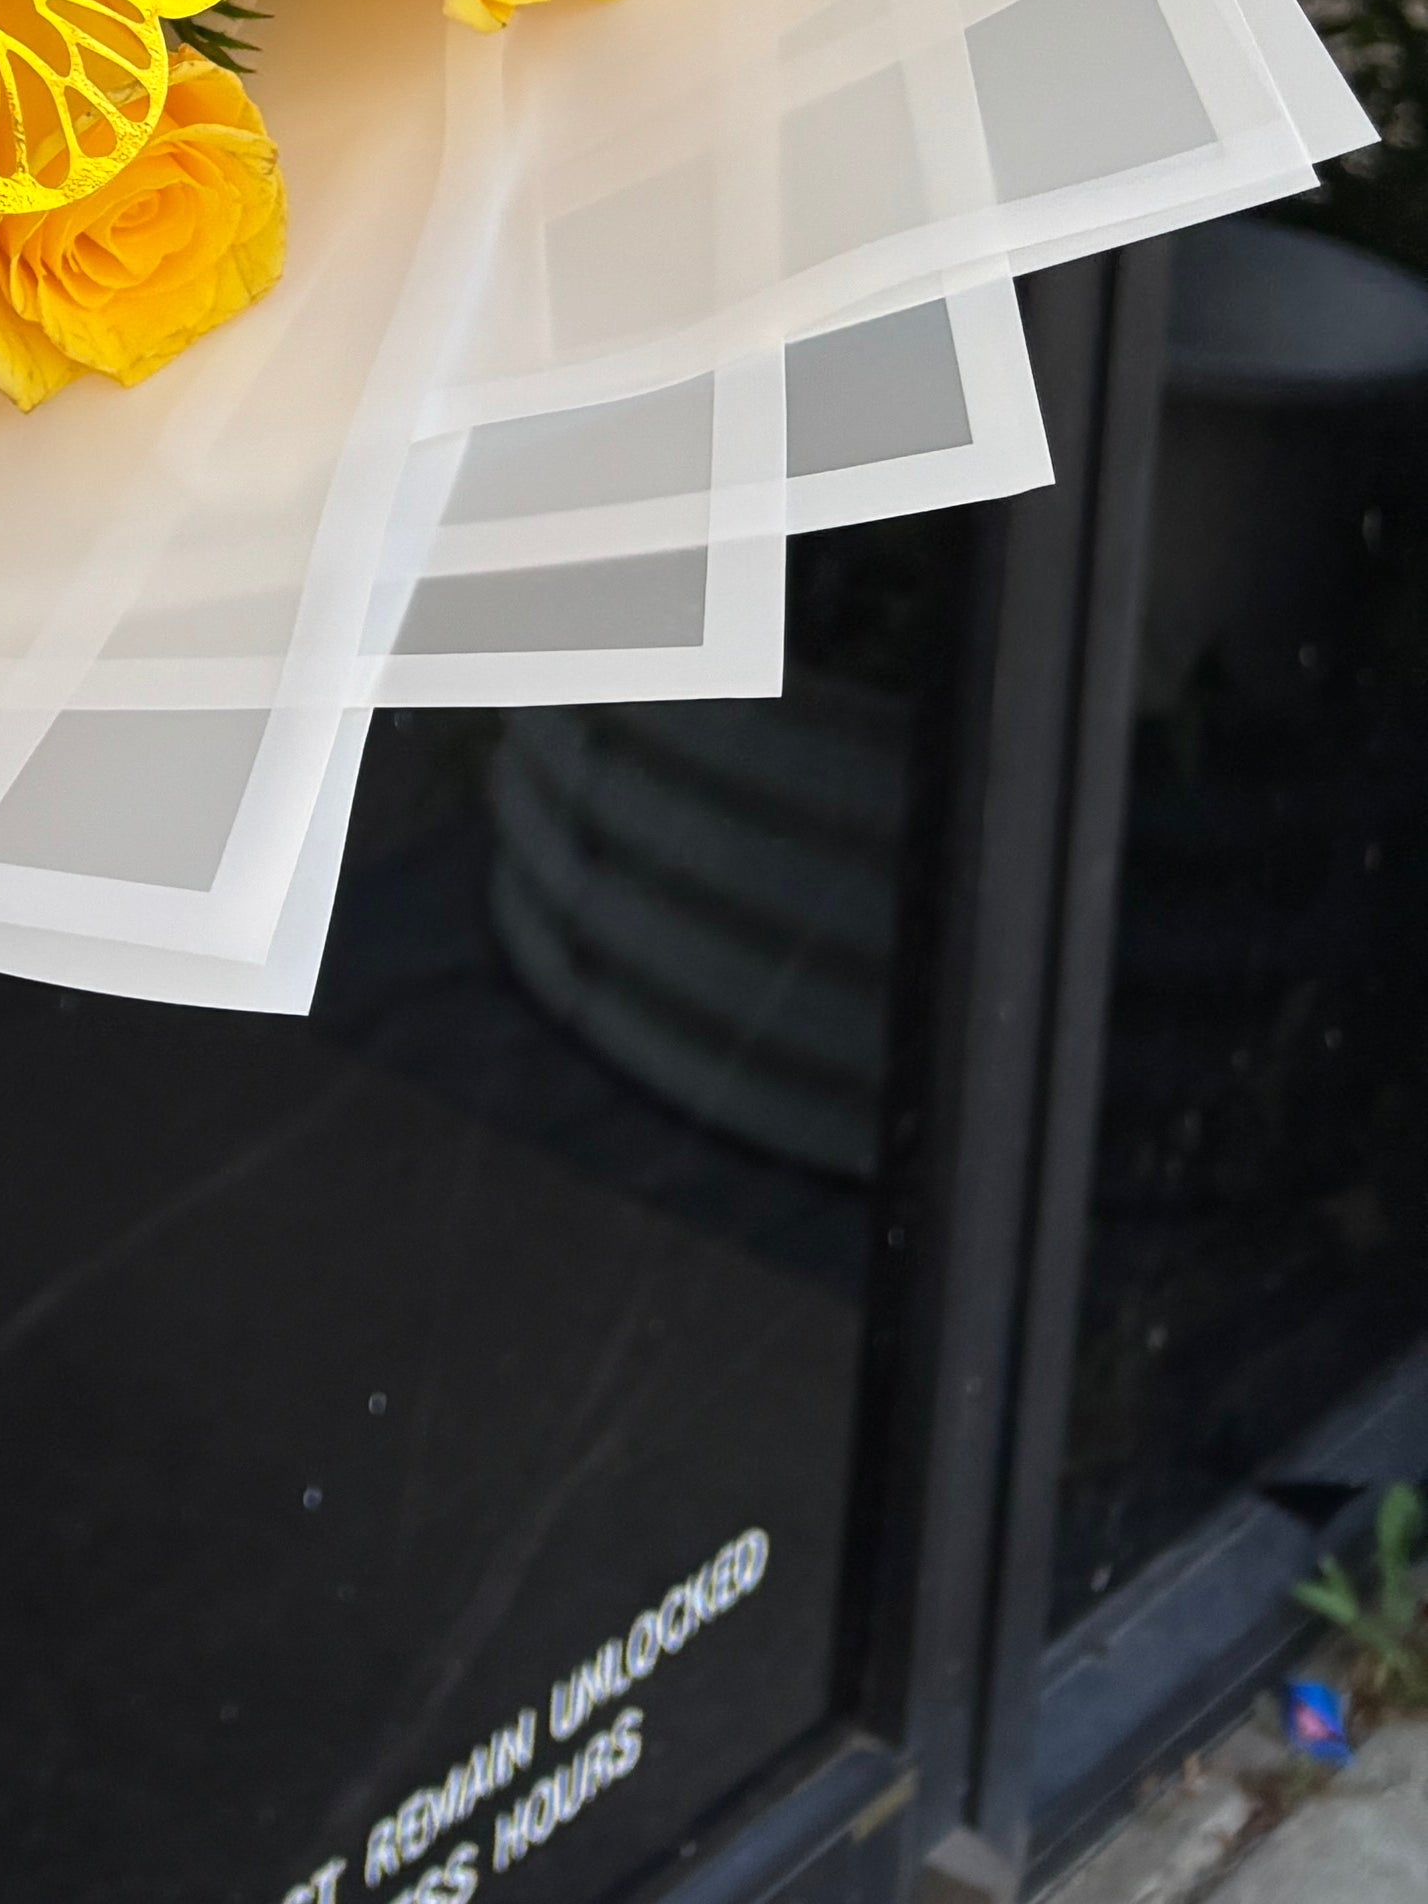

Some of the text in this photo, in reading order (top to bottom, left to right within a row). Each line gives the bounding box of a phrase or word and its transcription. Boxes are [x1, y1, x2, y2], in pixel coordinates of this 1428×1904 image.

[364, 1707, 537, 1888] REMAIN
[550, 1527, 769, 1742] UNLOCKED
[493, 1706, 644, 1873] HOURS
